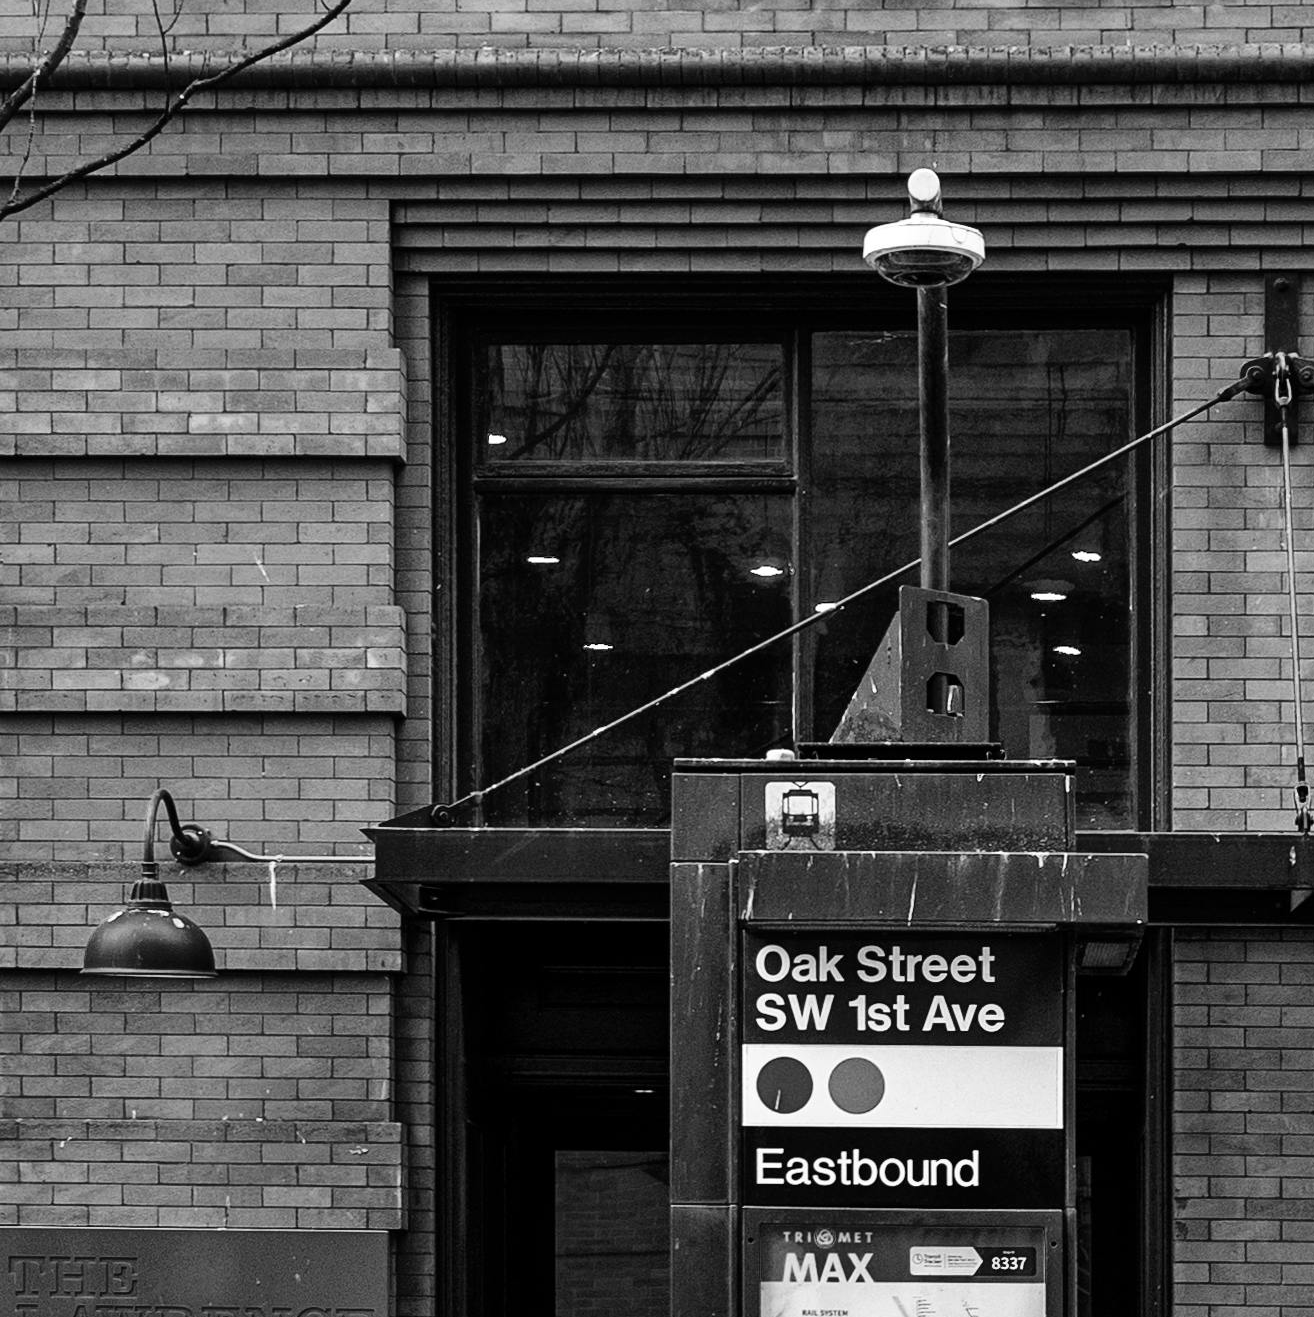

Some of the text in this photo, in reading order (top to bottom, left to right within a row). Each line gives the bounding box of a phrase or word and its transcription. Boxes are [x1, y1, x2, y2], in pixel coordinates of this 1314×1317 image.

[755, 944, 996, 983] Oak Street
[755, 993, 1006, 1032] SW 1st Ave
[755, 1148, 980, 1187] Eastbound
[7, 1255, 138, 1299] THE
[782, 1252, 875, 1283] MAX
[991, 1256, 1027, 1271] 8337
[802, 1309, 849, 1317] RAIL SYSTEM
